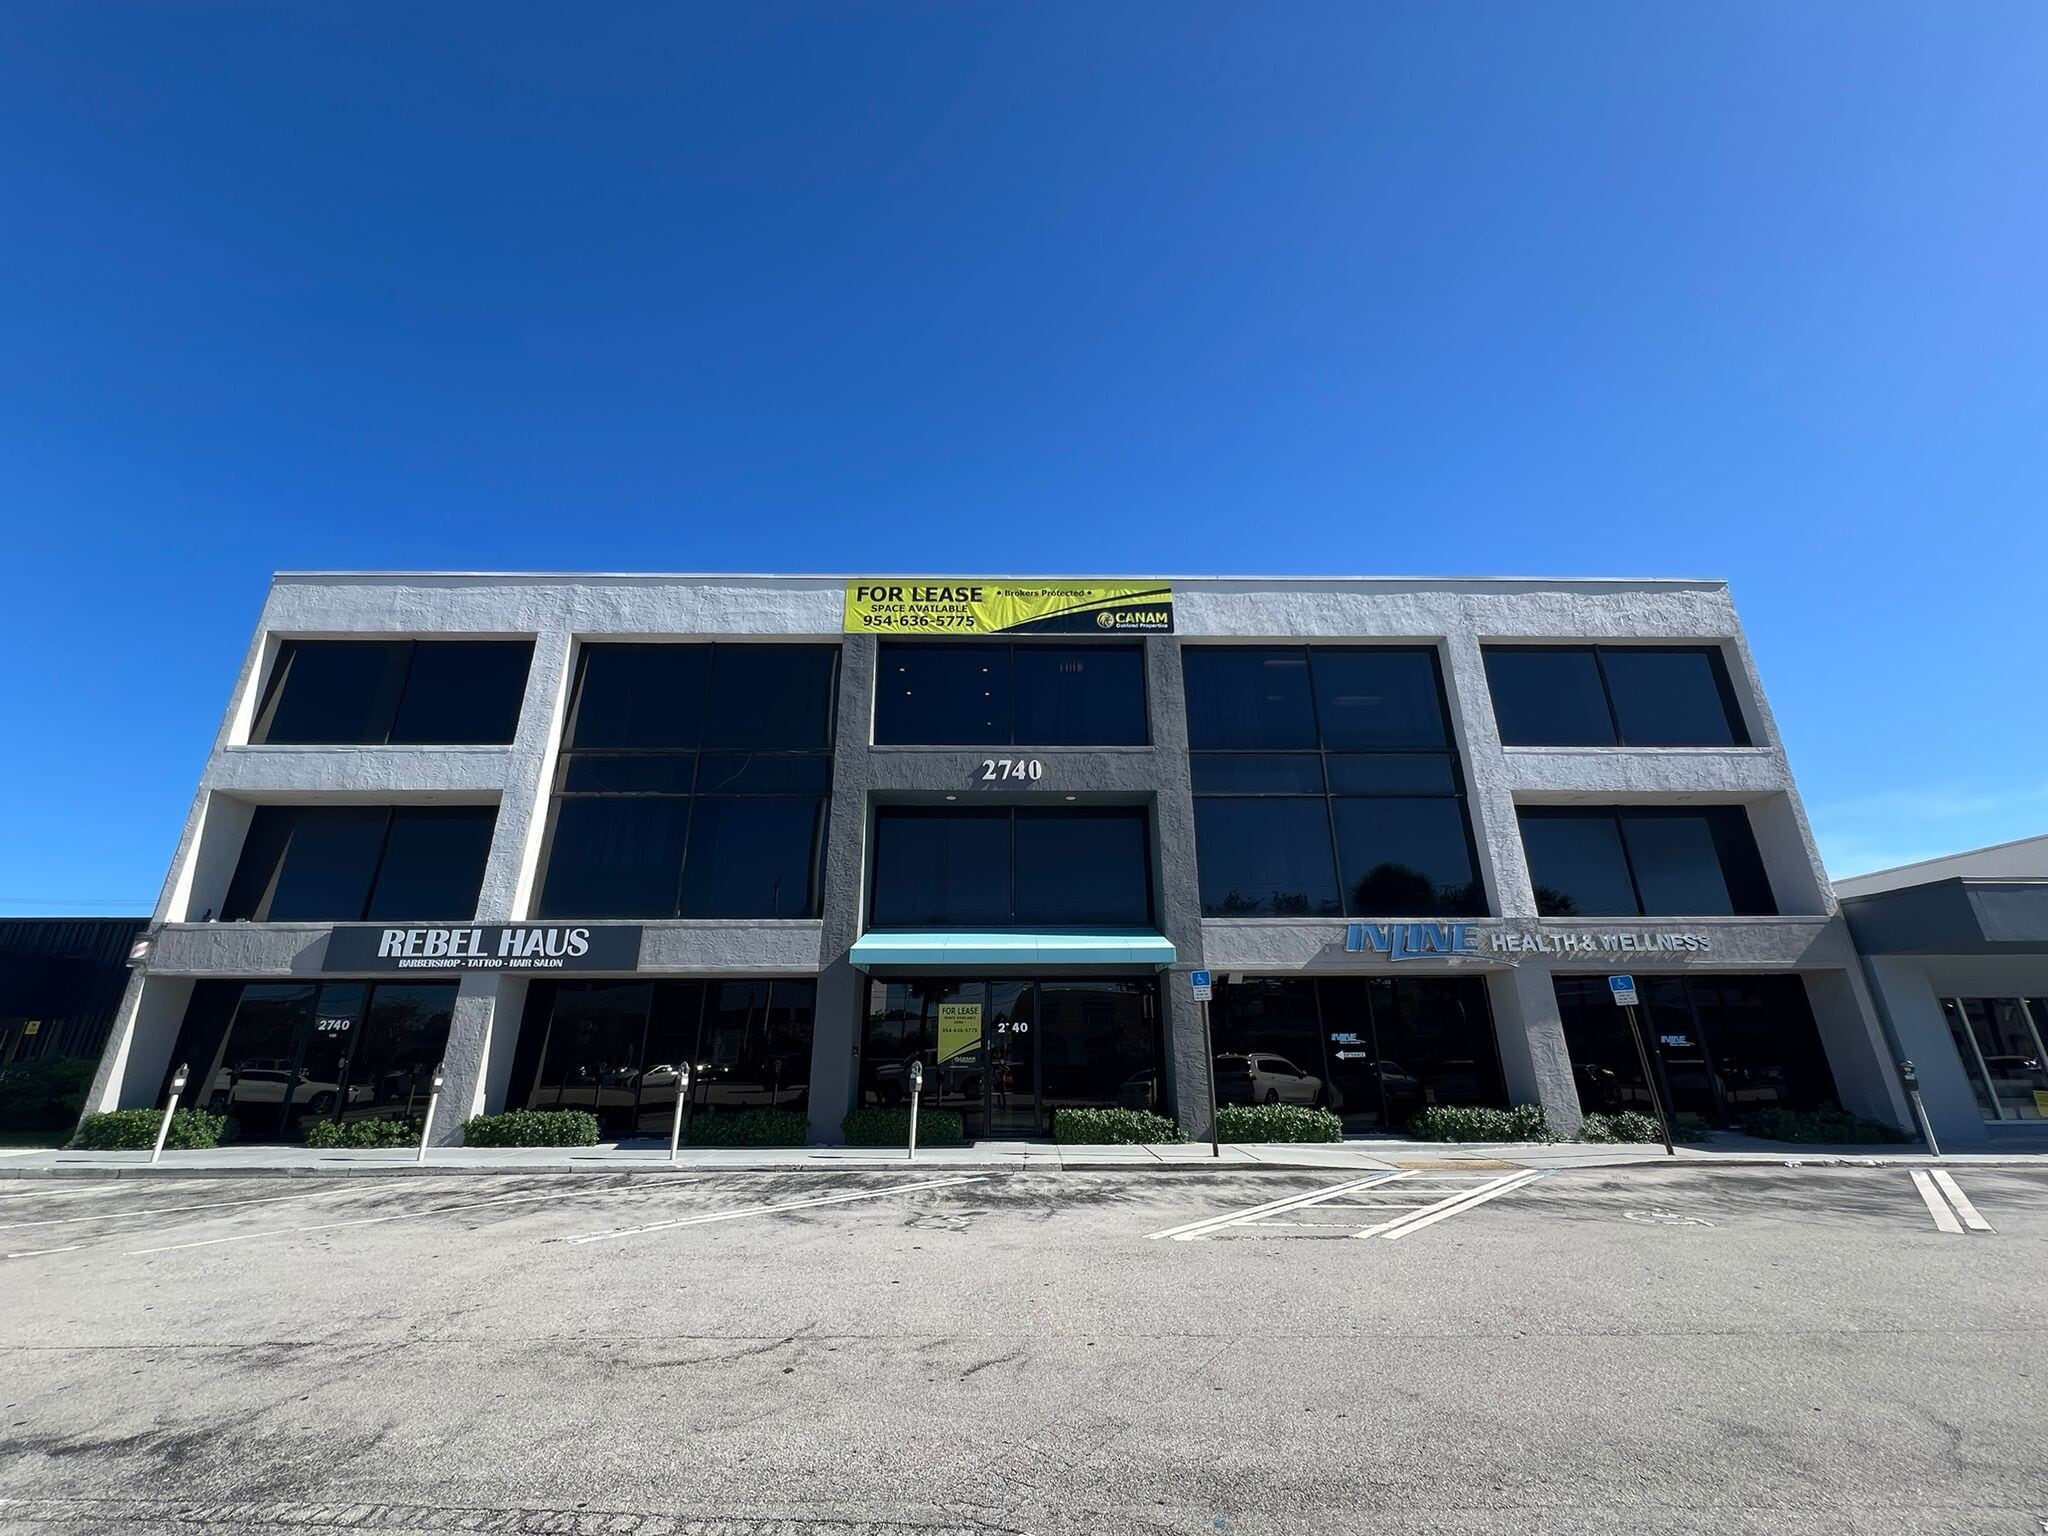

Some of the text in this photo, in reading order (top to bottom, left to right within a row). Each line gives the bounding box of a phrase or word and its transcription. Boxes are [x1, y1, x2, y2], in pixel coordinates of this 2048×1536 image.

[857, 586, 983, 602] FOR LEASE
[1041, 589, 1085, 597] Protected
[871, 604, 969, 612] SPACE AVAILABLE
[863, 615, 975, 626] 954-636-5775
[1115, 612, 1168, 623] CANAM
[982, 759, 1042, 780] 2740
[377, 928, 590, 957] REBEL HAUS
[1346, 922, 1480, 962] INLINE
[1491, 933, 1712, 952] HEALTH & WELLNESS
[398, 959, 461, 968] BARBERSHOP
[467, 959, 502, 968] TATTOO
[509, 959, 532, 968] HAIR
[533, 959, 563, 968] SALON
[942, 1007, 979, 1015] FOR LEASE
[318, 1020, 350, 1030] 2740
